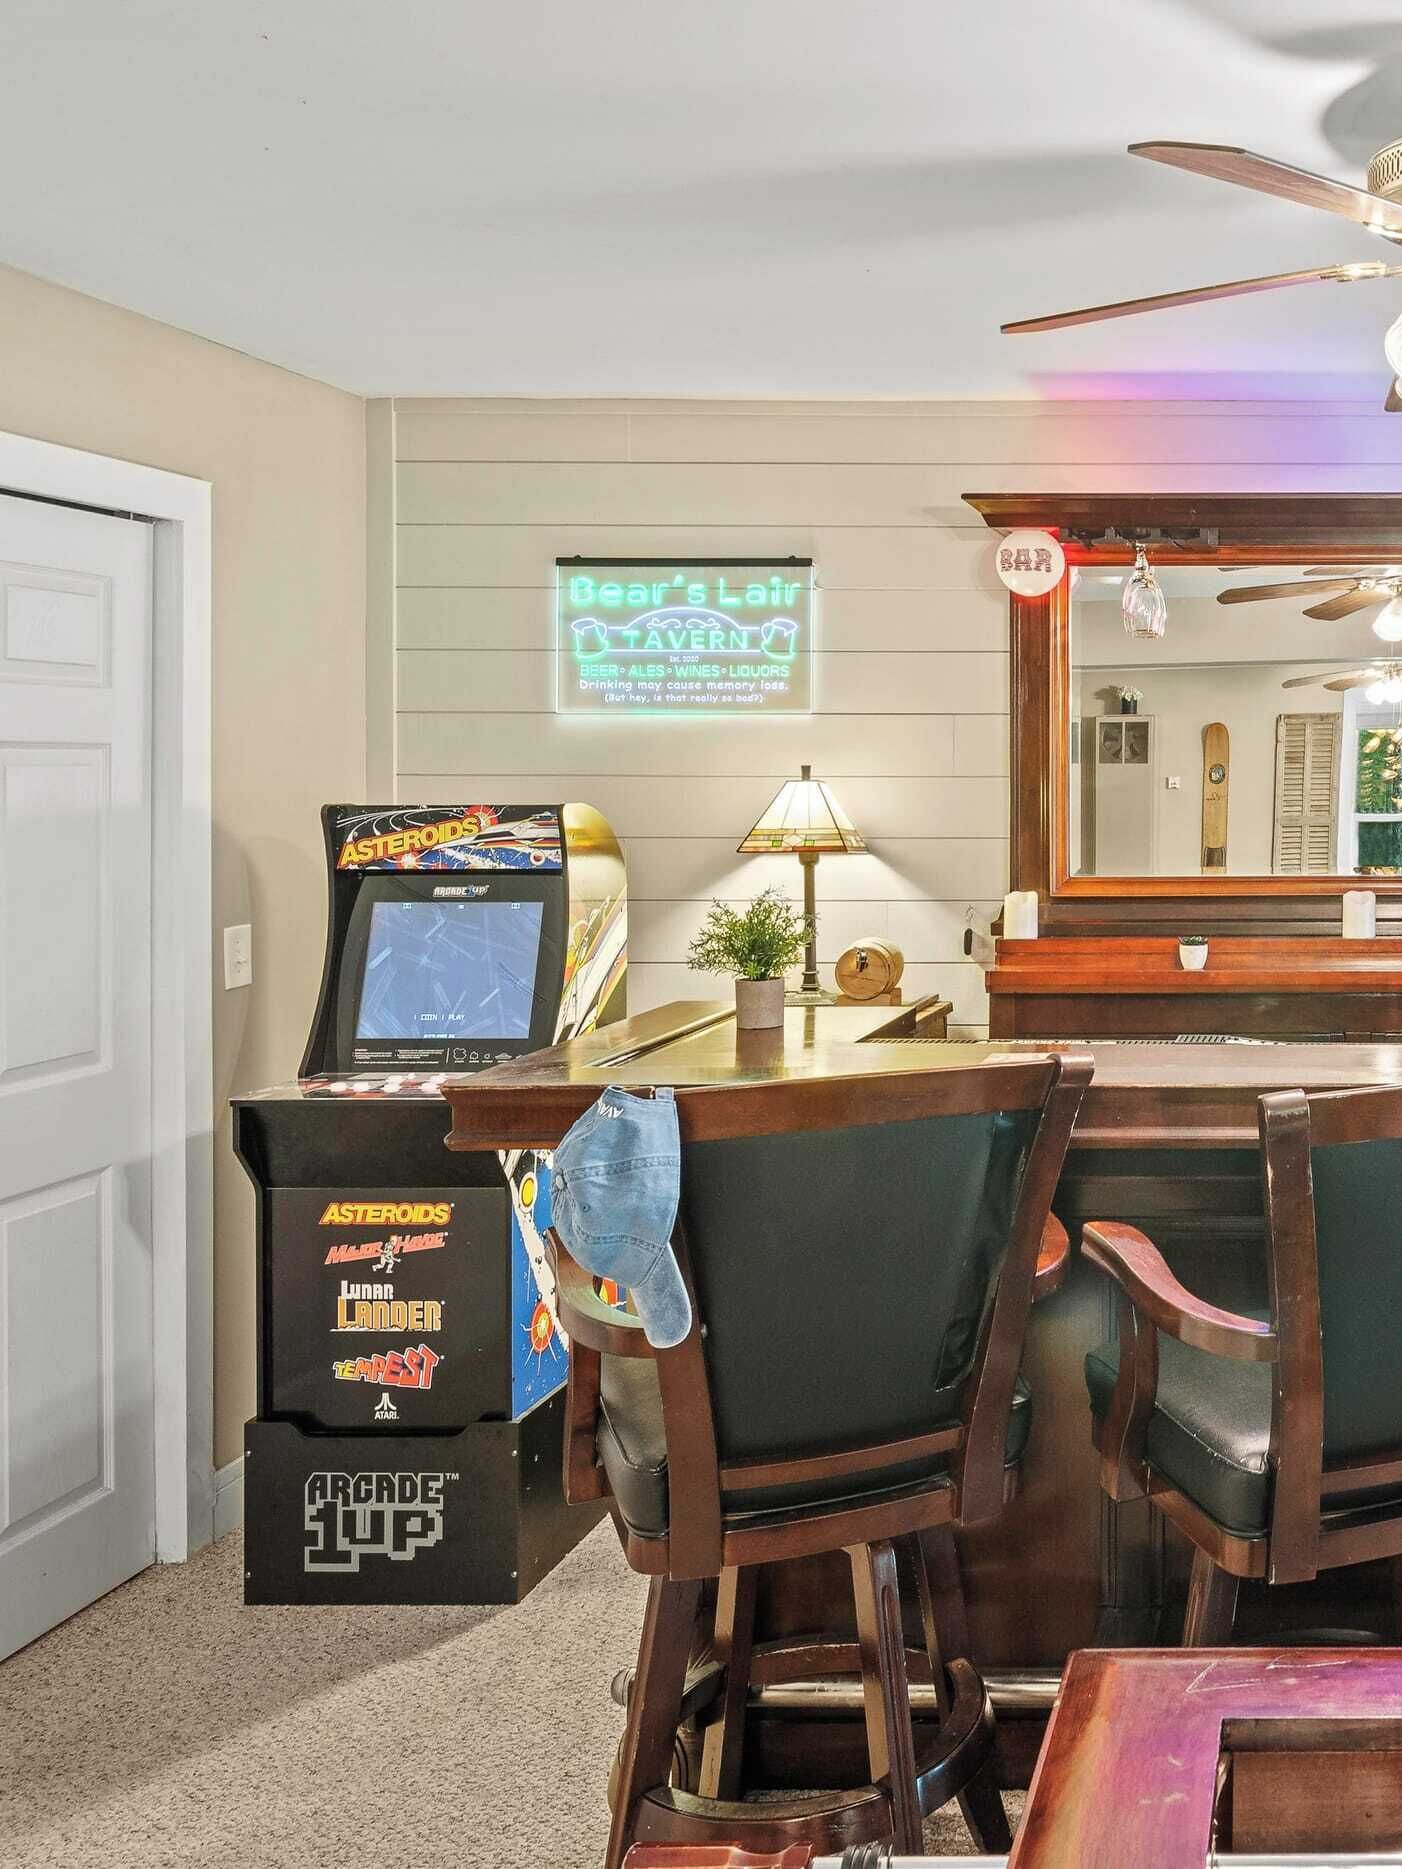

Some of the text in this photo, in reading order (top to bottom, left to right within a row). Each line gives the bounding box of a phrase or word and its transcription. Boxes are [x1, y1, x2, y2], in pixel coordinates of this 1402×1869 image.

[1000, 548, 1052, 572] BAR
[570, 574, 801, 606] Bear's Lair
[622, 630, 748, 649] TAVERN
[580, 664, 790, 677] BEER ALES WINES LIQUORS
[579, 680, 789, 692] Drinking may cause memory loss.
[653, 693, 662, 702] is
[666, 693, 686, 702] that
[690, 693, 718, 704] really
[337, 815, 481, 869] ASTEROIDS
[319, 1202, 452, 1226] ASTEROIDS
[337, 1295, 442, 1331] LANDER
[333, 1343, 440, 1389] TEMPEST
[305, 1472, 444, 1505] ARCADE
[304, 1500, 444, 1573] 1UP
